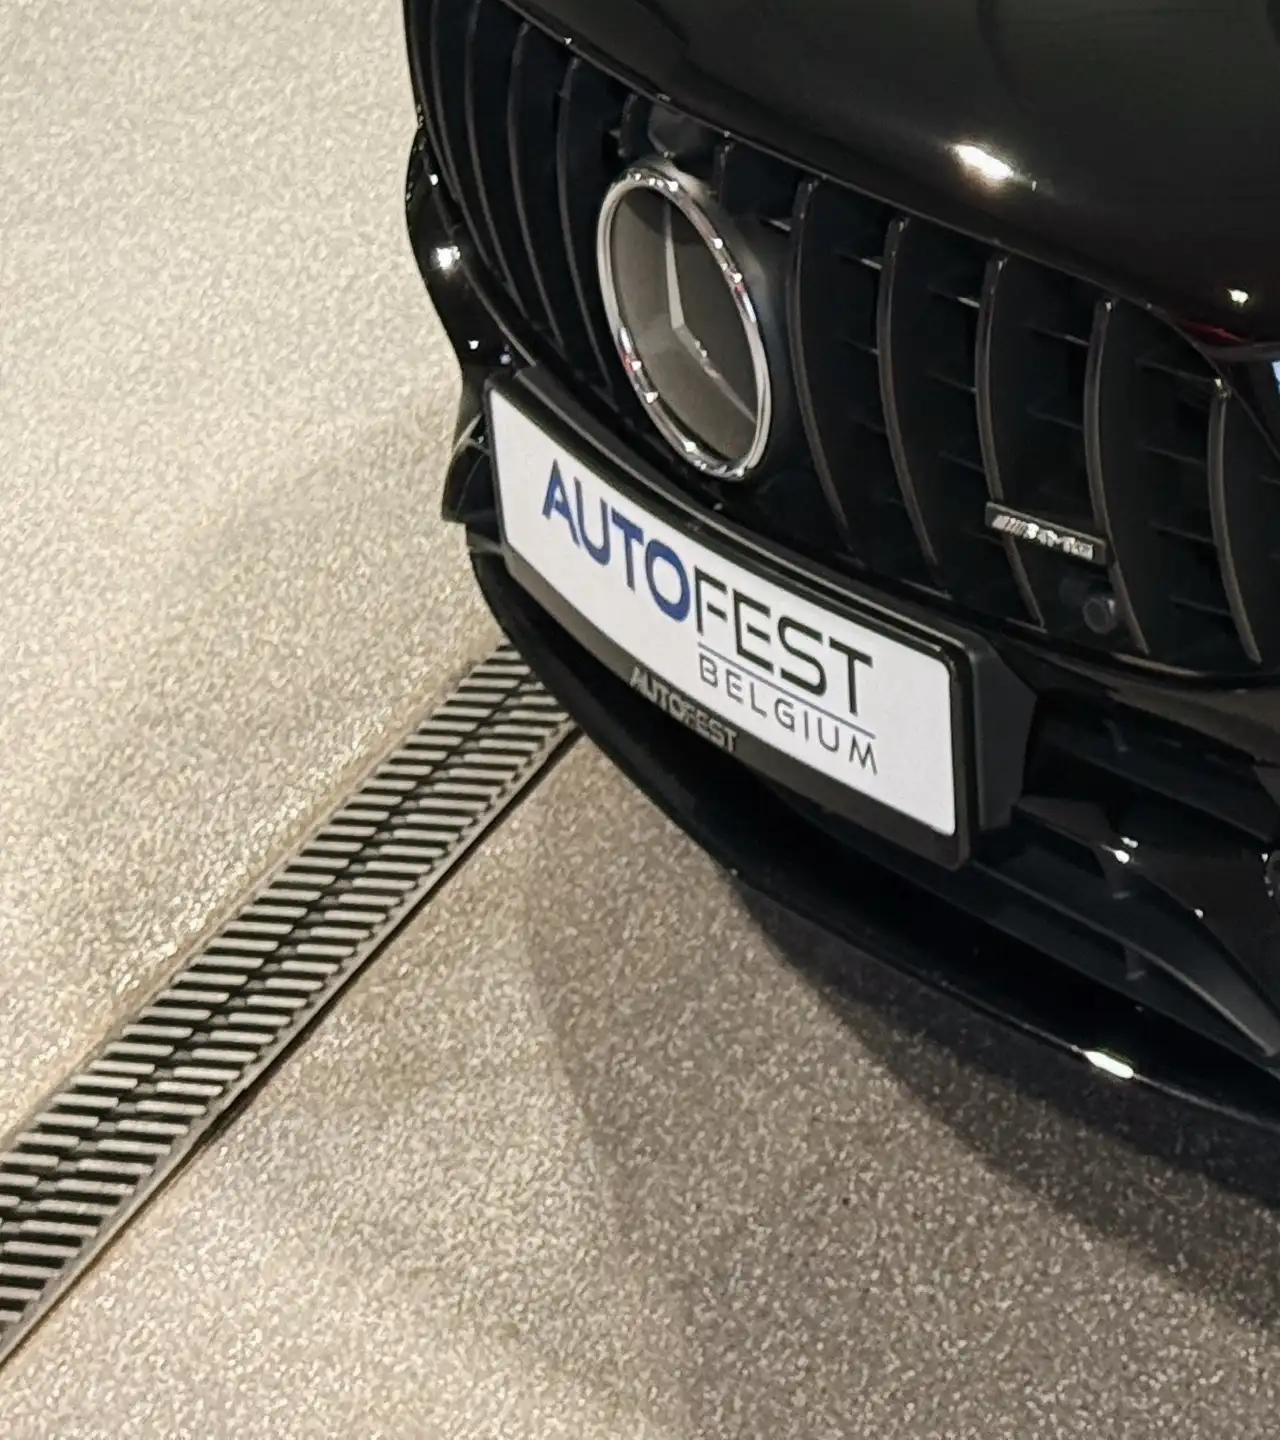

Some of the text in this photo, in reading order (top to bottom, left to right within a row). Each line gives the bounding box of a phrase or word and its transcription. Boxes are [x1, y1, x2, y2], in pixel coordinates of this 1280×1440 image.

[542, 458, 874, 717] AUTOFEST
[628, 666, 739, 753] AUTOFEST
[699, 653, 878, 775] BELGIUM
